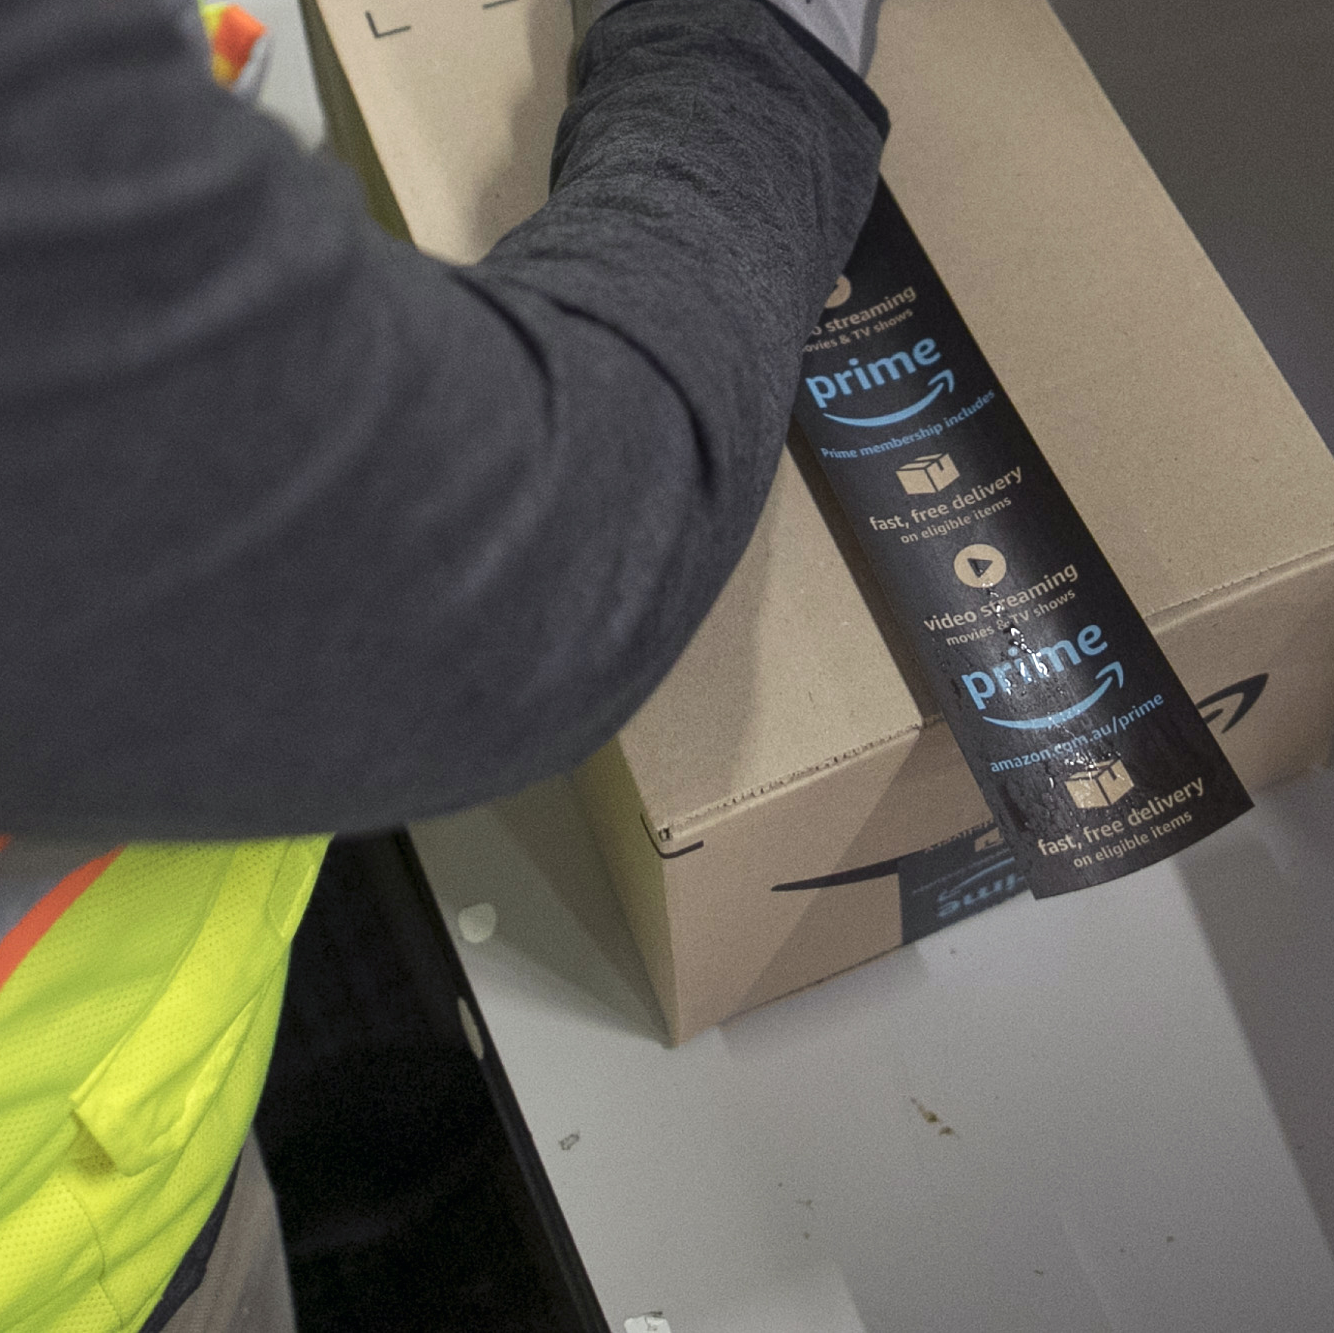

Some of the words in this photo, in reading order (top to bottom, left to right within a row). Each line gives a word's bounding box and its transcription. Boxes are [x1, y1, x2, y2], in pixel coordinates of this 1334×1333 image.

[802, 338, 838, 353] ovies
[840, 334, 852, 346] &
[852, 326, 871, 342] TV
[873, 308, 914, 333] shows
[825, 286, 917, 334] streaming
[805, 337, 942, 409] prime
[821, 447, 858, 460] Prime
[860, 421, 944, 457] membership
[944, 389, 996, 428] includes
[869, 515, 910, 531] fast,
[911, 504, 950, 524] free
[952, 466, 1023, 510] delivery
[900, 533, 919, 544] on
[921, 516, 972, 540] eligible
[973, 496, 1012, 520] items
[924, 611, 977, 632] video
[980, 564, 1079, 618] streaming
[946, 626, 995, 647] movies
[996, 618, 1010, 630] &
[1008, 610, 1031, 625] TV
[1033, 588, 1076, 617] shows
[961, 624, 1108, 710] prime
[990, 693, 1164, 773] amazon.com.au/prime
[1037, 833, 1083, 856] fast,
[1083, 818, 1125, 844] free
[1127, 777, 1205, 827] delivery
[1073, 855, 1093, 869] on
[1095, 832, 1150, 865] eligible
[1150, 809, 1193, 839] items
[937, 874, 1027, 919] ime
